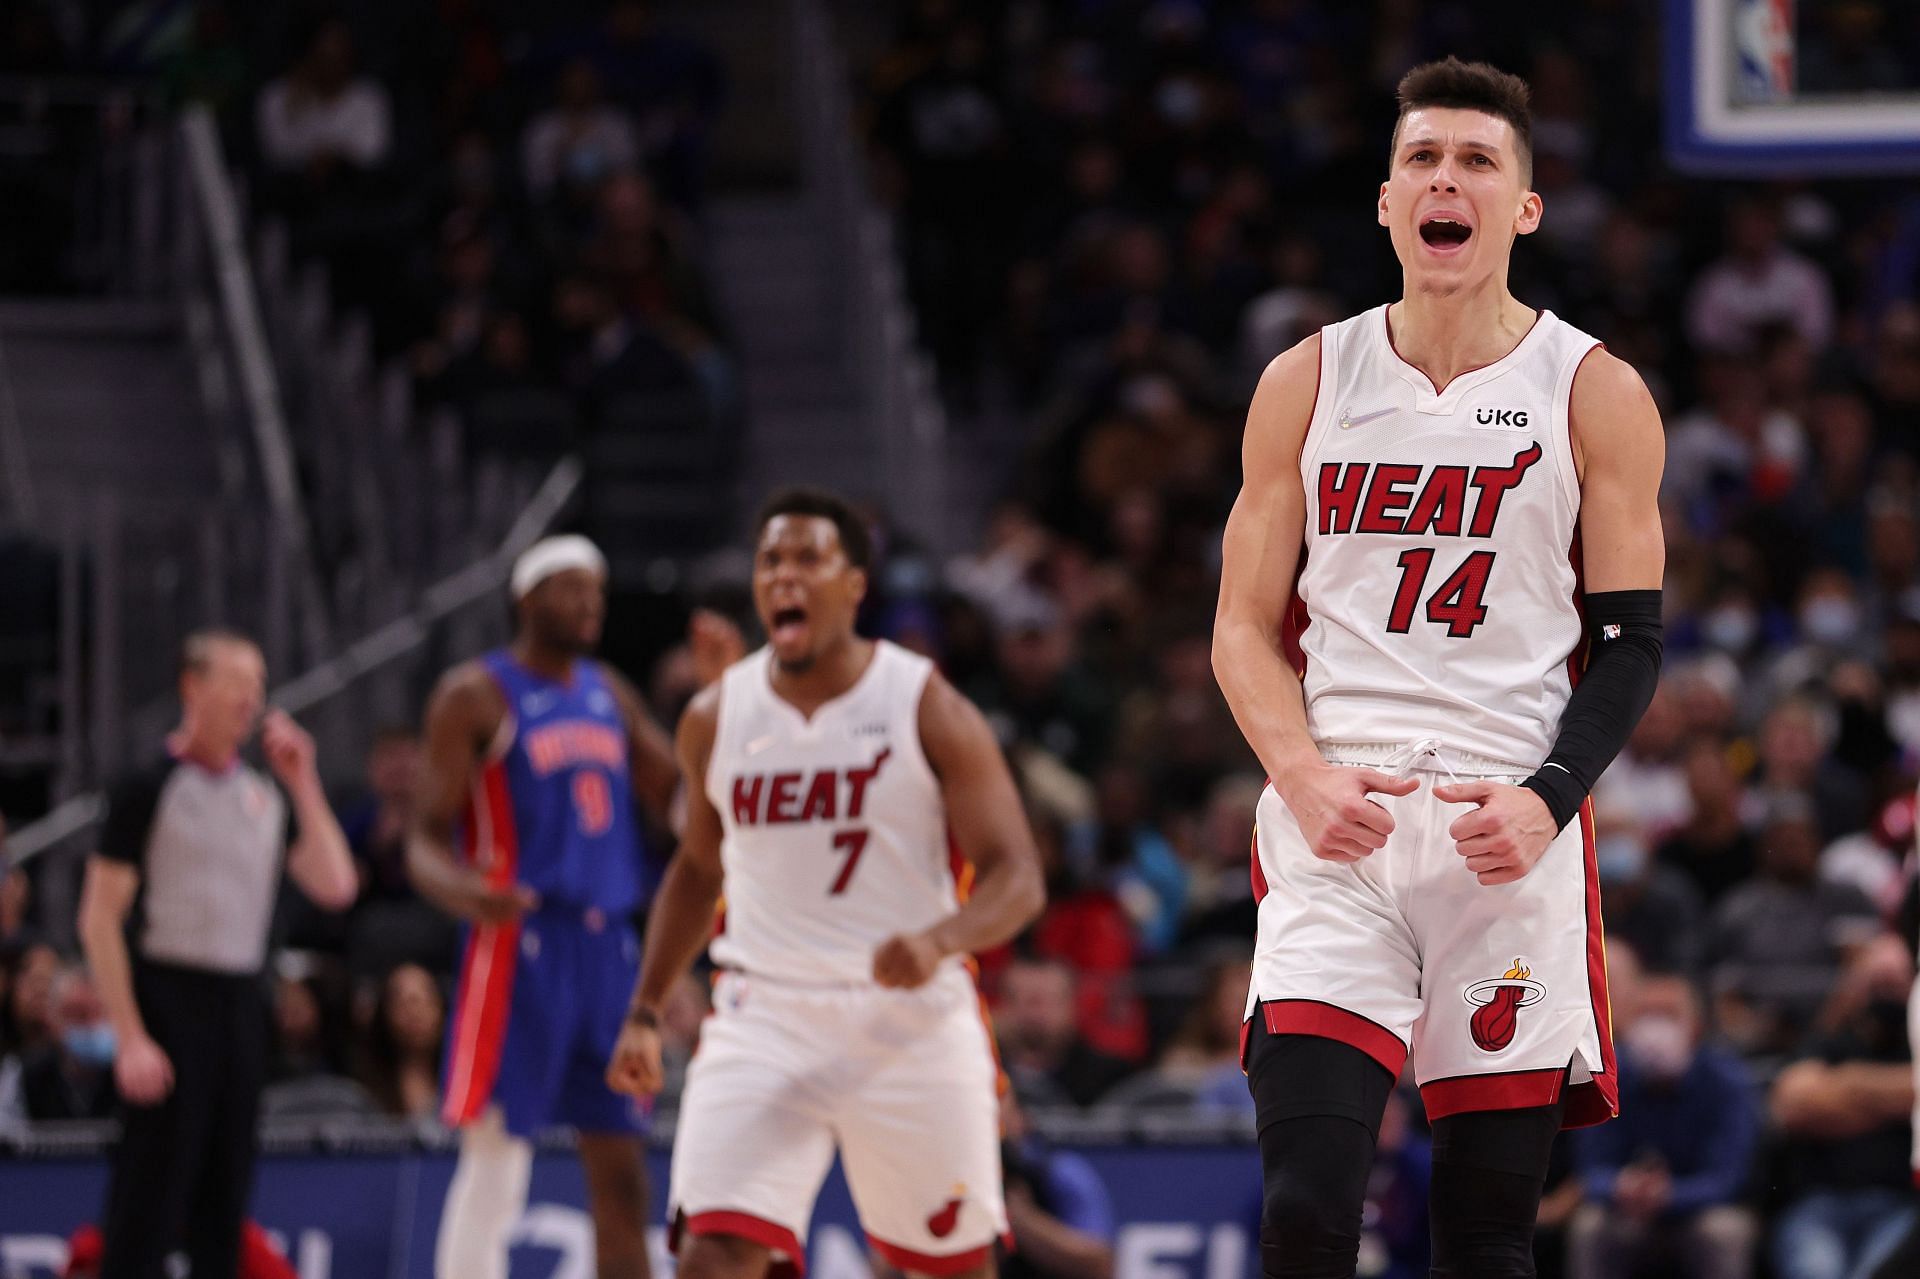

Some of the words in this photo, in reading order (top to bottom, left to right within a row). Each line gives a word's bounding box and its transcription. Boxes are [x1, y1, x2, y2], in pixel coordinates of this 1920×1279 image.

[1318, 440, 1543, 538] HEAT
[1386, 547, 1497, 638] 14
[732, 746, 891, 825] HEAT
[829, 828, 869, 895] 7
